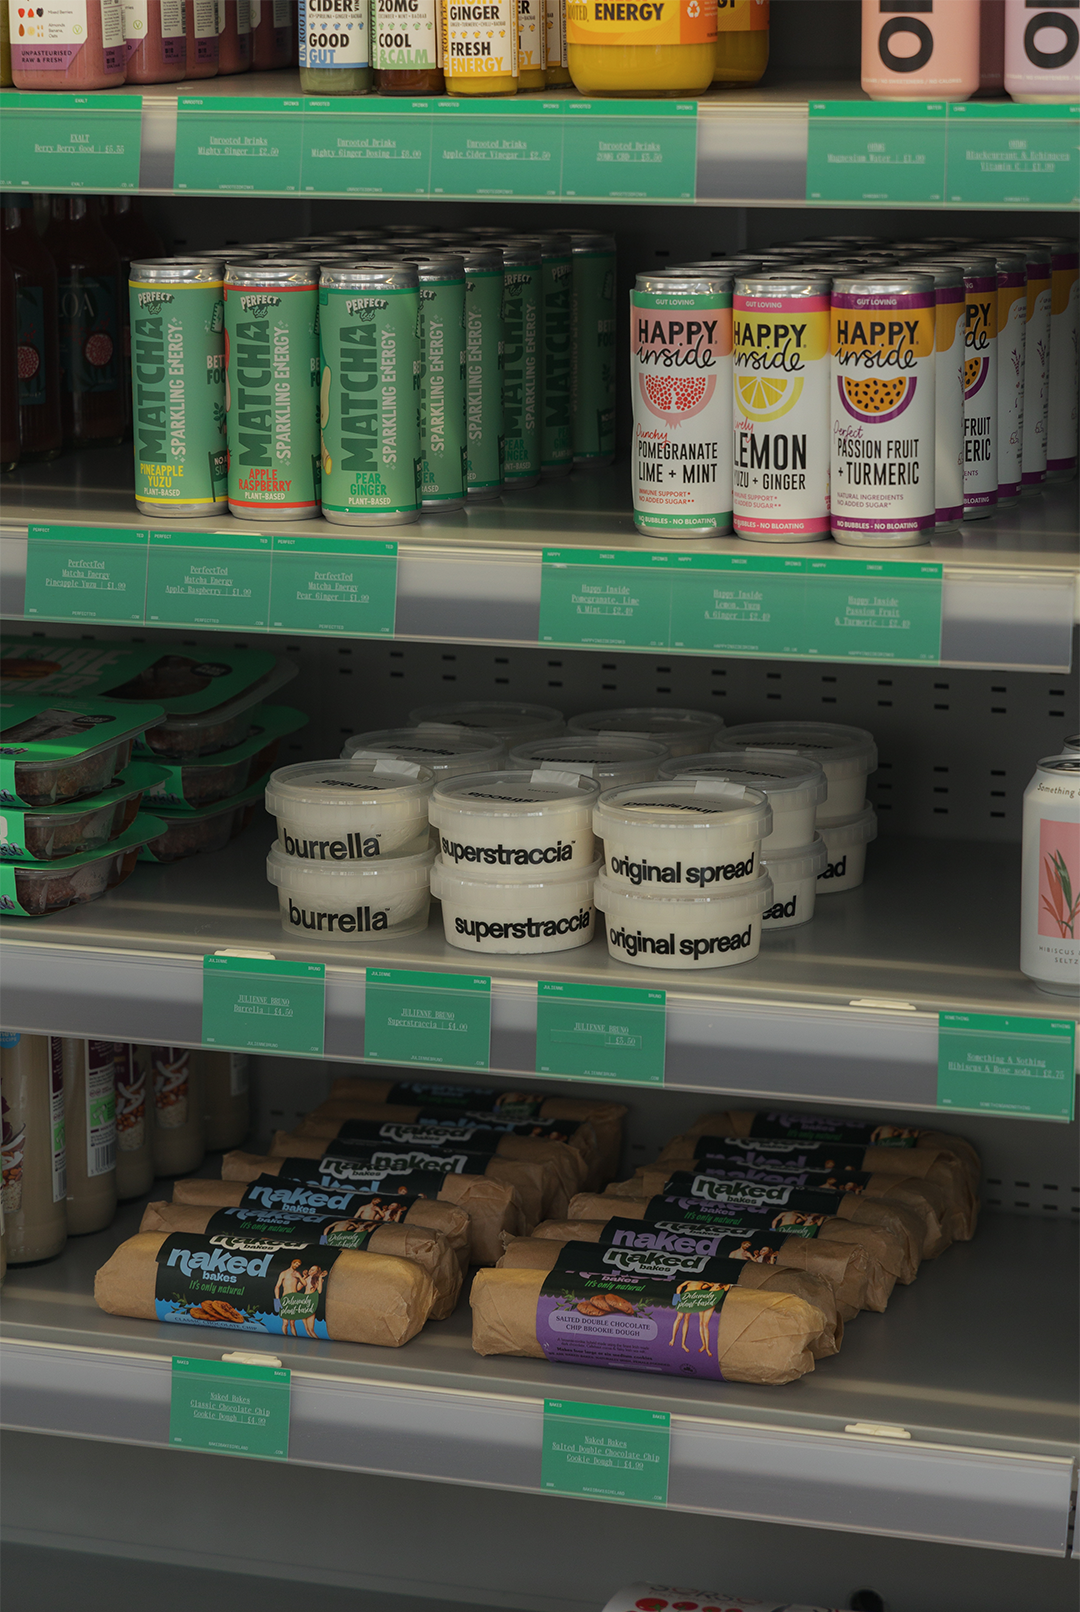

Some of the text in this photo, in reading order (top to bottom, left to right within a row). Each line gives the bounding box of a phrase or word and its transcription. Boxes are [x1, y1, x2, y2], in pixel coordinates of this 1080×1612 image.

[309, 0, 352, 12] CIDER
[378, 0, 418, 12] 20MG
[450, 6, 500, 20] GINGER
[594, 3, 664, 21] ENERGY
[309, 34, 350, 48] GOOD
[379, 34, 412, 48] COOL
[450, 42, 491, 56] FRESH
[309, 49, 336, 64] GUT
[451, 57, 504, 73] ENERGY
[210, 136, 268, 146] Unrooted Drinks
[337, 138, 396, 148] Unrooted Drinks
[466, 140, 527, 149] Unrooted Drinks
[598, 142, 660, 151] Unrooted Drinks
[34, 144, 94, 153] Berry Berry Good
[197, 147, 221, 156] Mighty
[224, 147, 248, 156] Ginger
[311, 148, 335, 157] Mighty
[338, 149, 362, 158] Ginger
[442, 150, 519, 160] Apple Cider Vinegar
[138, 291, 172, 306] PERFECT
[240, 294, 279, 310] PERFECT
[346, 298, 387, 314] PERFECT
[639, 319, 718, 345] HAPPY
[734, 322, 807, 348] HAPPY
[837, 320, 919, 346] HAPPY
[636, 335, 717, 368] inside
[835, 336, 918, 369] inside
[468, 311, 482, 440] SPARKLING ENERGY
[135, 317, 167, 463] MATCHA
[168, 322, 186, 456] SPARKLING ENERGY
[273, 326, 291, 460] SPARKLING ENERGY
[429, 320, 445, 452] SPARKLING ENERGY
[236, 320, 272, 467] MATCHA
[340, 323, 378, 472] MATCHA
[380, 330, 397, 464] SPARKLING ENERGY
[639, 441, 718, 460] POMEGRANATE
[734, 434, 806, 471] LEMON
[838, 438, 919, 459] PASSION FRUIT
[140, 463, 184, 477] PINEAPPLE
[249, 469, 277, 480] APPLE
[639, 461, 717, 484] LIME MINT
[846, 461, 919, 485] TURMERIC
[148, 476, 172, 488] YUZU
[238, 478, 292, 492] RASPBERRY
[355, 472, 381, 484] PEAR
[763, 473, 806, 490] GINGER
[143, 488, 180, 497] PLANT-BASED
[244, 491, 285, 500] PLANT-BASED
[350, 484, 387, 496] GINGER
[861, 493, 904, 501] INGREDIENTS
[348, 497, 391, 506] PLANT-BASED
[774, 522, 804, 530] BLOATING
[845, 520, 918, 530] BUBBLES BLOATING
[62, 569, 110, 580] Matcha Energy
[184, 576, 233, 586] Matcha Energy
[314, 571, 353, 581] PerfectTed
[45, 578, 78, 588] Pineapple
[308, 582, 358, 592] Matcha Energy
[582, 584, 630, 595] Happy Inside
[165, 586, 184, 594] Apple
[188, 586, 222, 596] Raspberry
[296, 591, 312, 600] Pear
[315, 592, 339, 601] Ginger
[1037, 782, 1075, 798] Something
[611, 852, 754, 888] original spread
[610, 924, 752, 960] original spread
[1039, 945, 1075, 956] HIBISCUS
[238, 994, 289, 1006] JULIENNE BRUNO
[234, 1004, 264, 1014] Burrella
[401, 1008, 454, 1020] JULIENNE BRUNO
[388, 1017, 437, 1028] Superstraccia
[574, 1022, 629, 1034] JULIENNE BRUNO
[248, 1185, 355, 1210] naked
[611, 1229, 720, 1256] naked
[166, 1248, 273, 1279] naked
[202, 1270, 237, 1283] bakes
[189, 1280, 245, 1296] It's only natural
[585, 1280, 646, 1292] It's only natural
[556, 1316, 650, 1330] SALTED DOUBLE CHOCOLATE
[583, 1325, 614, 1334] BROOKIE
[615, 1328, 640, 1337] DOUGH
[210, 1392, 228, 1402] Naked
[190, 1400, 270, 1417] Classic Chocolate Chip
[193, 1410, 237, 1422] Cookie Dough
[584, 1435, 627, 1448] Naked Bakes
[552, 1442, 660, 1462] Salted Double Chocolate Chip
[567, 1453, 613, 1467] Cookie Dough
